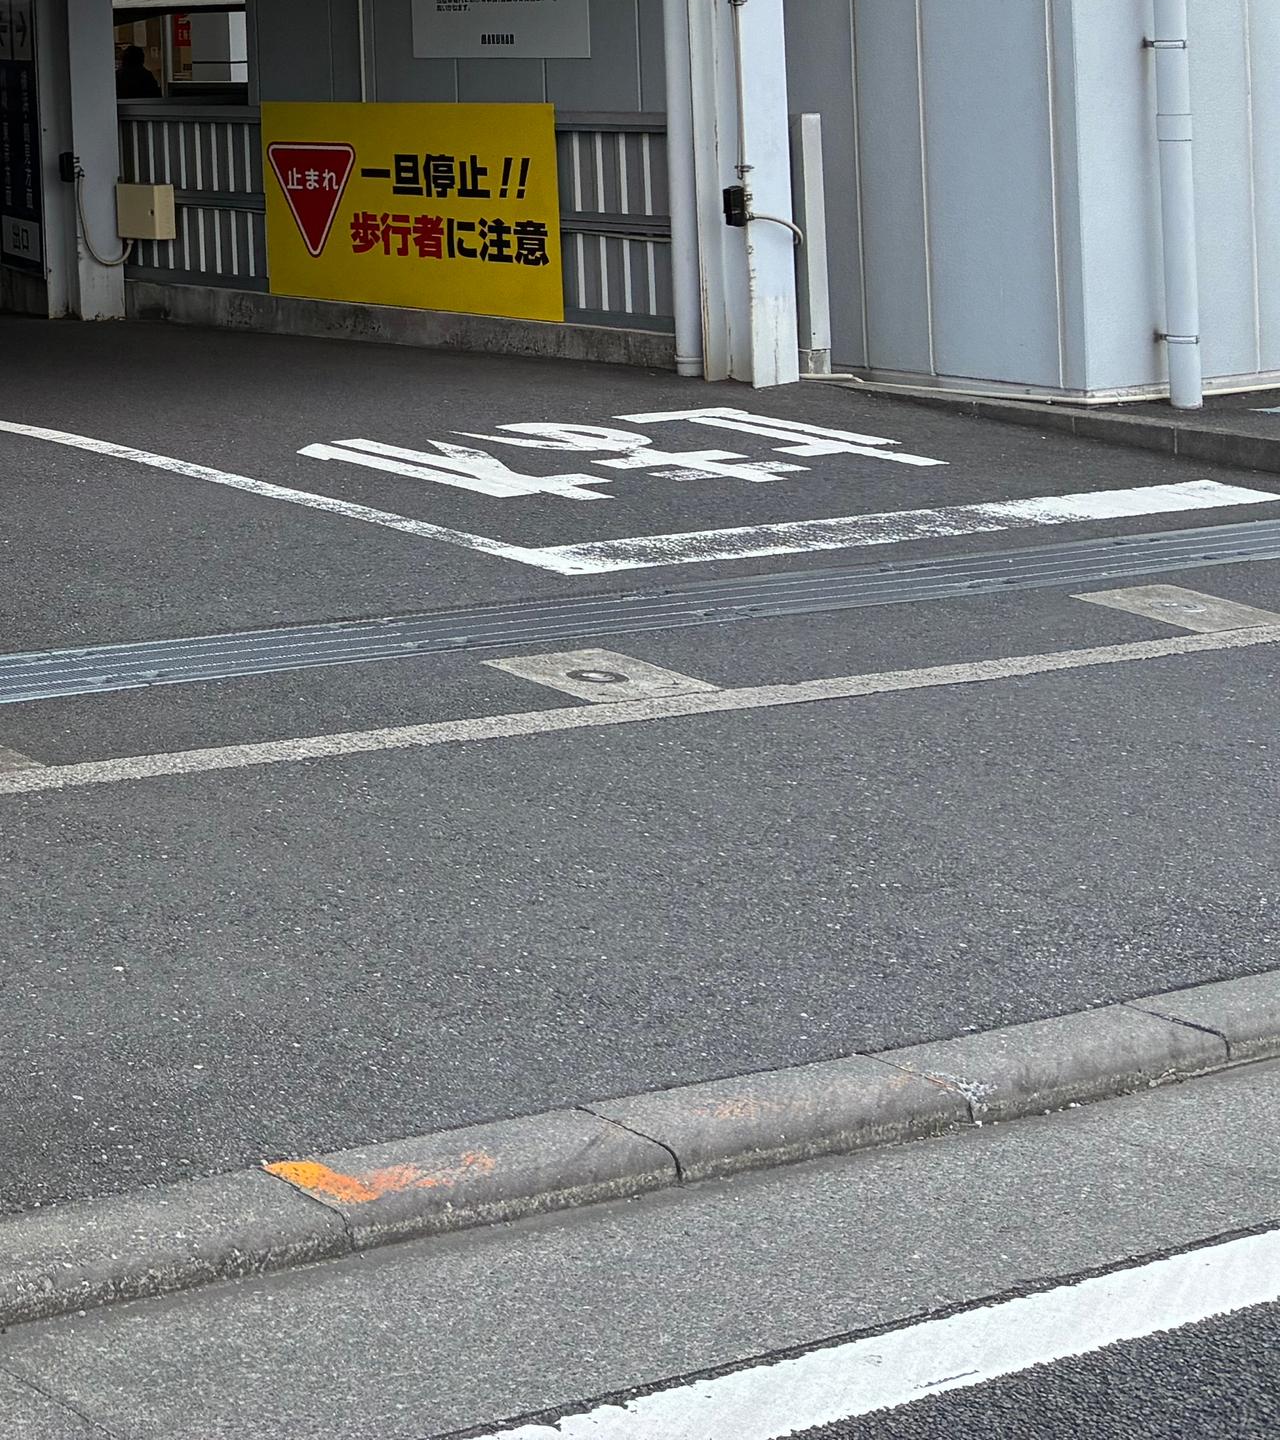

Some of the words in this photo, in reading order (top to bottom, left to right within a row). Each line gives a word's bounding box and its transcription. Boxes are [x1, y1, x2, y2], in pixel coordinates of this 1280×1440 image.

[286, 167, 340, 193] 止まれ
[351, 213, 550, 267] 歩行者に注意
